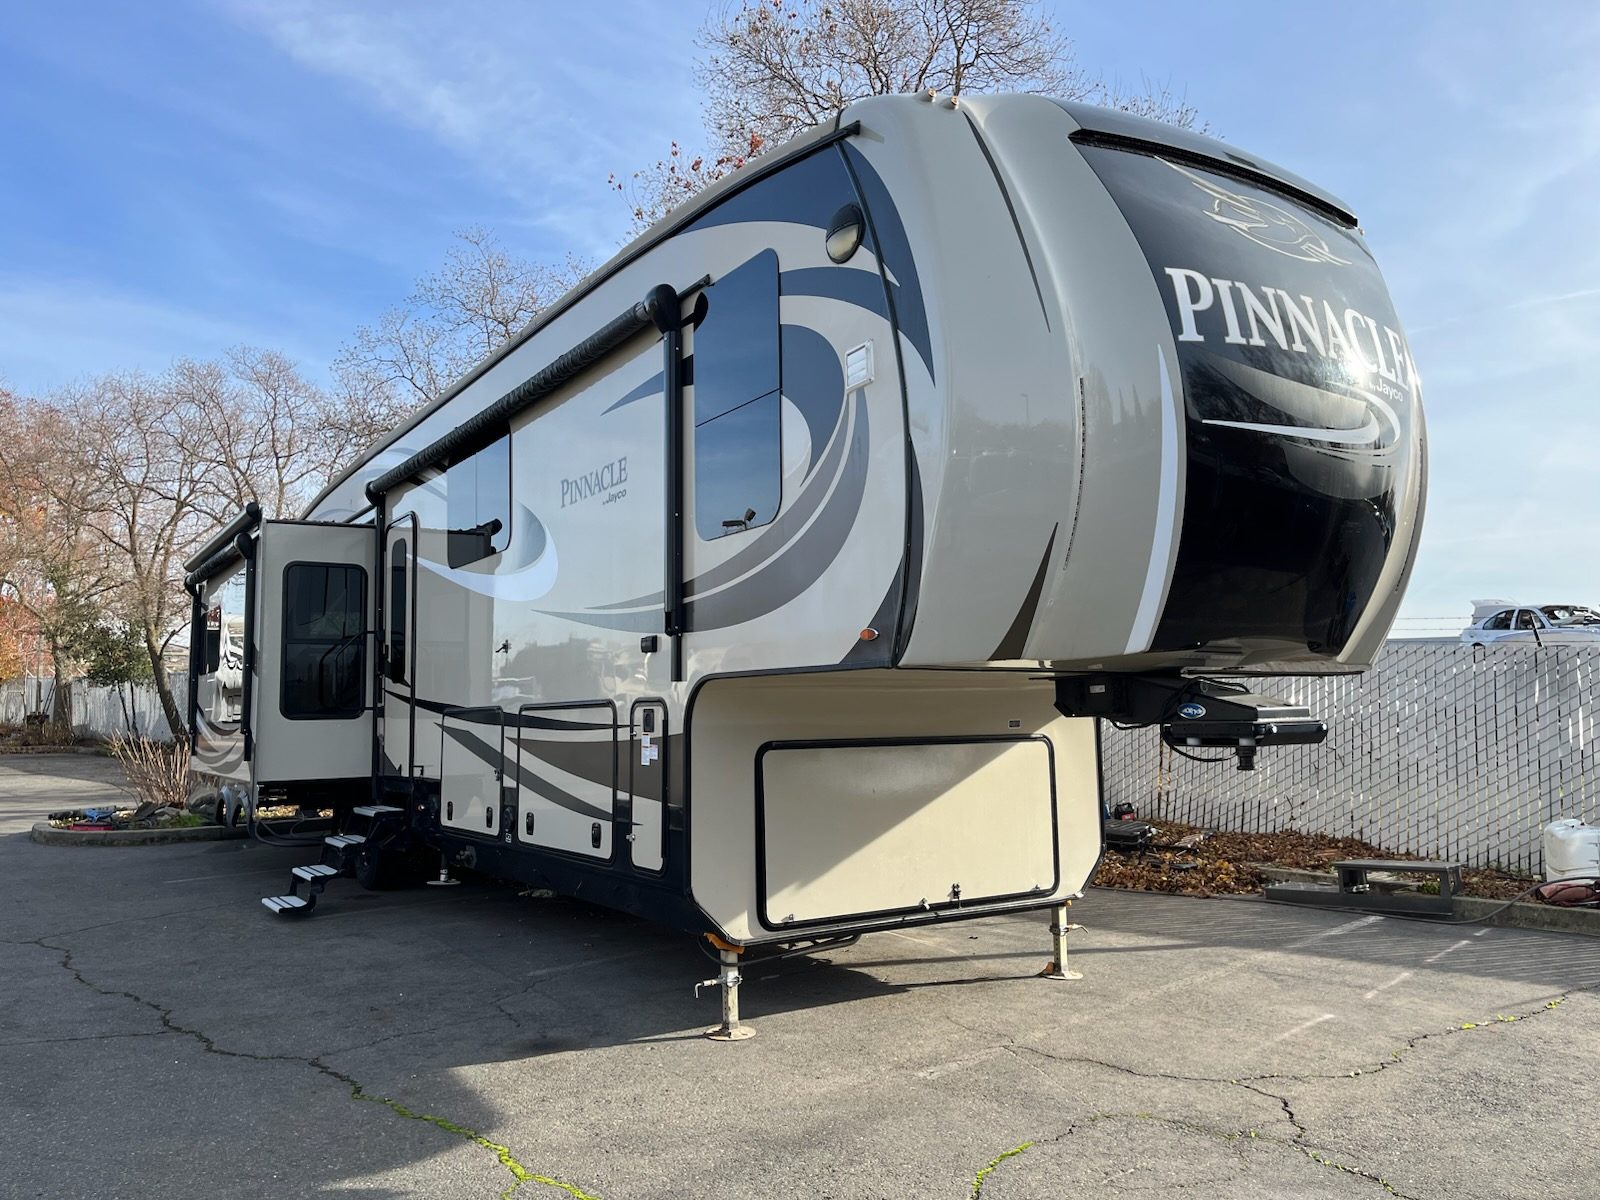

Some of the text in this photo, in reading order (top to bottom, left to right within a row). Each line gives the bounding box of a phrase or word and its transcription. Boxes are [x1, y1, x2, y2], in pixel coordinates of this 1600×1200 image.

[1164, 266, 1408, 391] PINNACLE
[1376, 377, 1404, 402] Jayco
[560, 455, 628, 509] PINNACLE
[608, 488, 627, 503] Jayco
